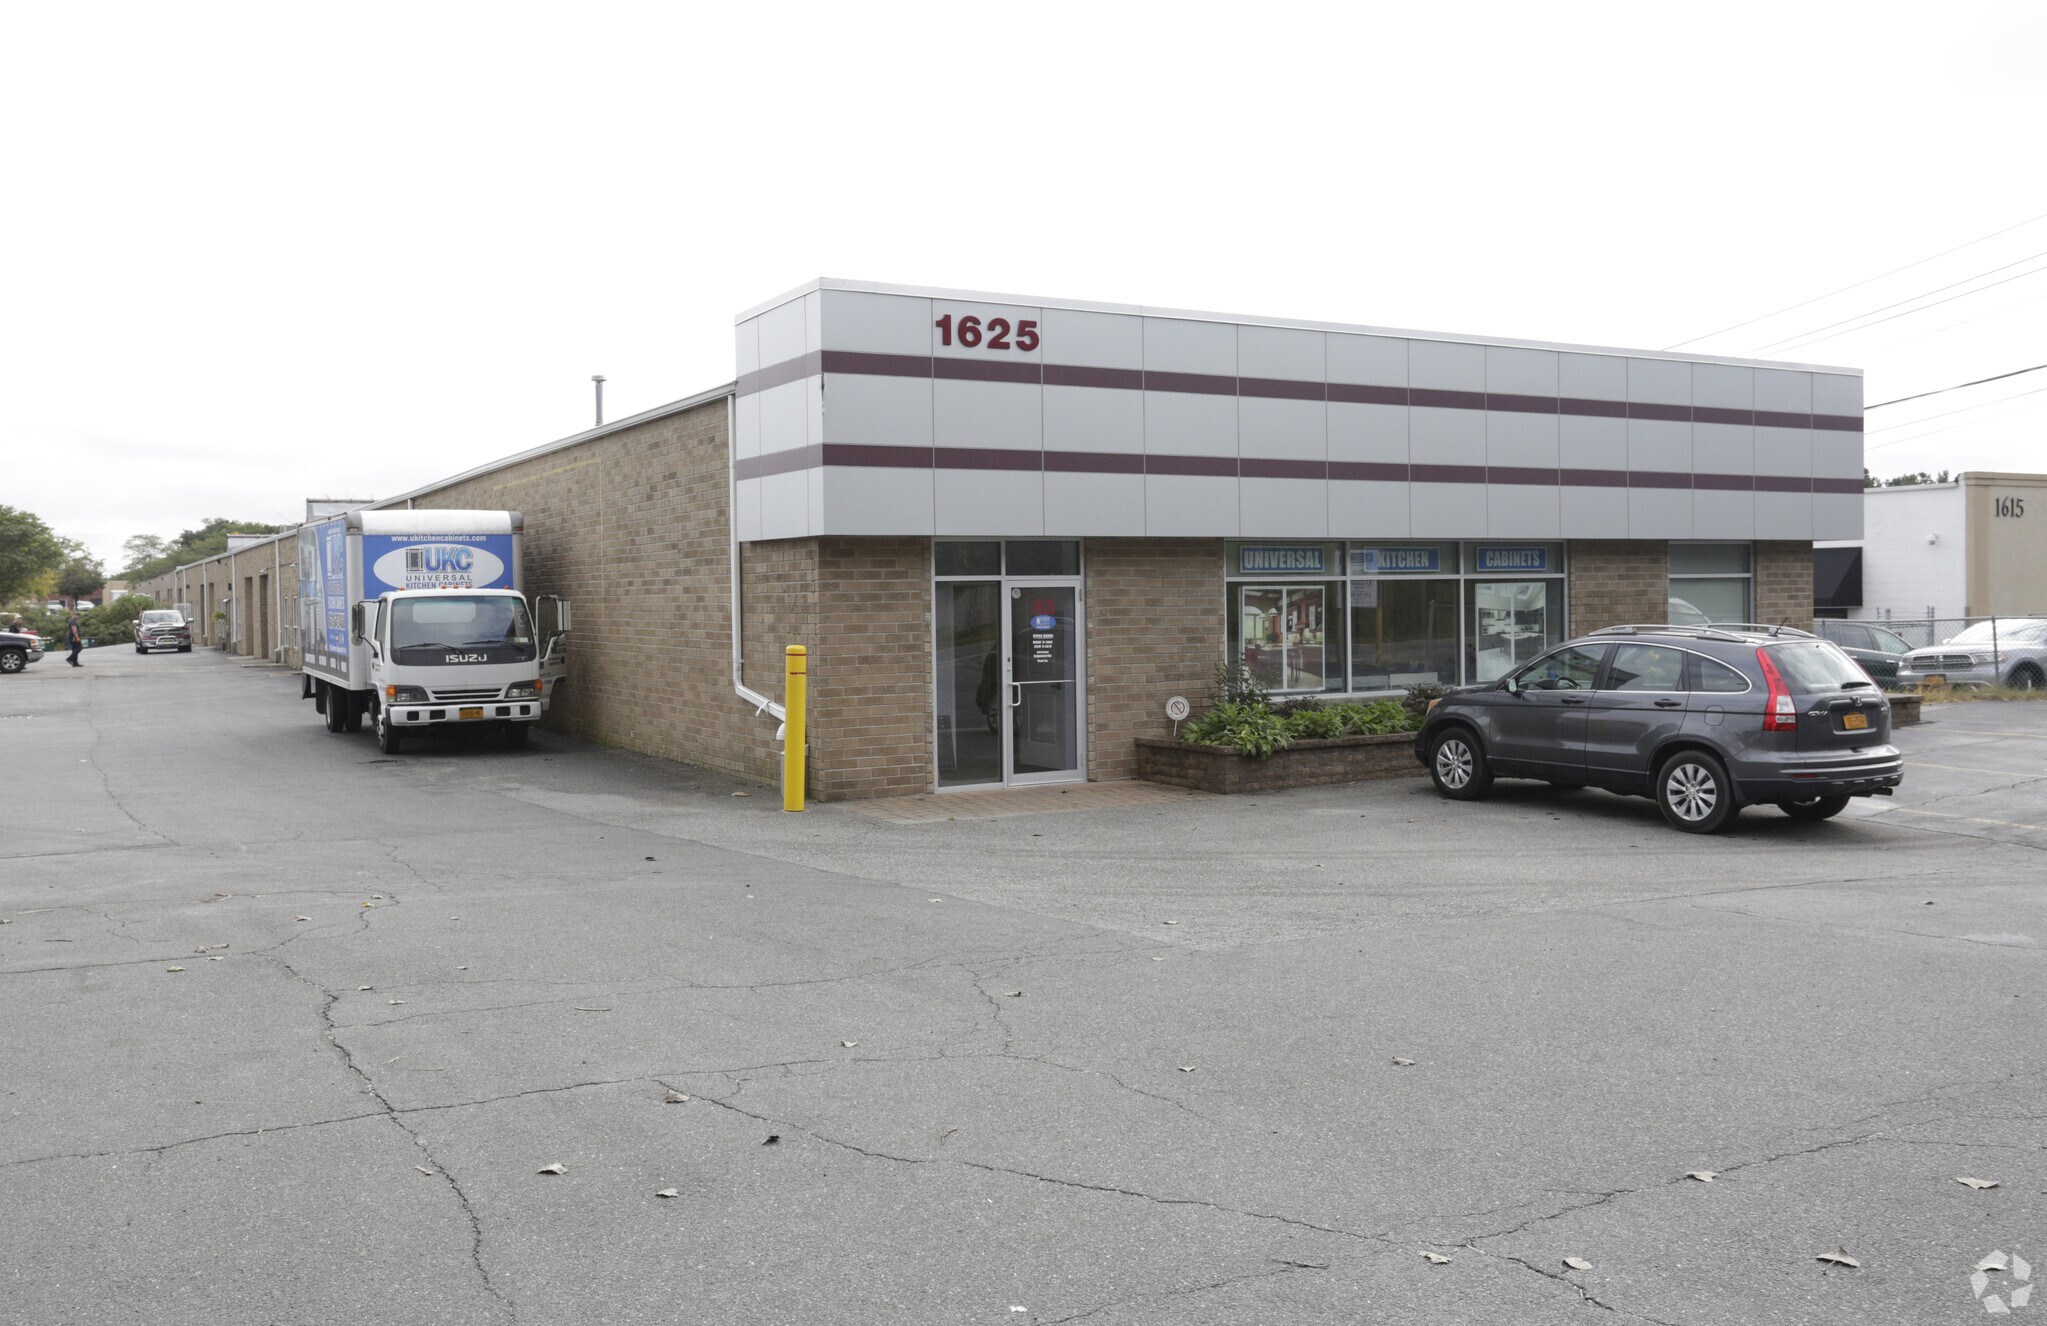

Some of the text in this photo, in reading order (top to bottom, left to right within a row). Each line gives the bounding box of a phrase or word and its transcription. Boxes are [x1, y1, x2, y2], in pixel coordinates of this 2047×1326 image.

[935, 314, 1040, 351] 1625
[1995, 496, 2024, 518] 1615
[391, 534, 487, 542] www.ukitchencabinets.com
[423, 546, 474, 573] UKC
[1244, 550, 1540, 568] UNIVERSAL KITCHEN CABINETS
[405, 574, 473, 582] UNIVERSAL
[405, 581, 437, 590] KITCHEN
[445, 653, 488, 663] ISUZU
